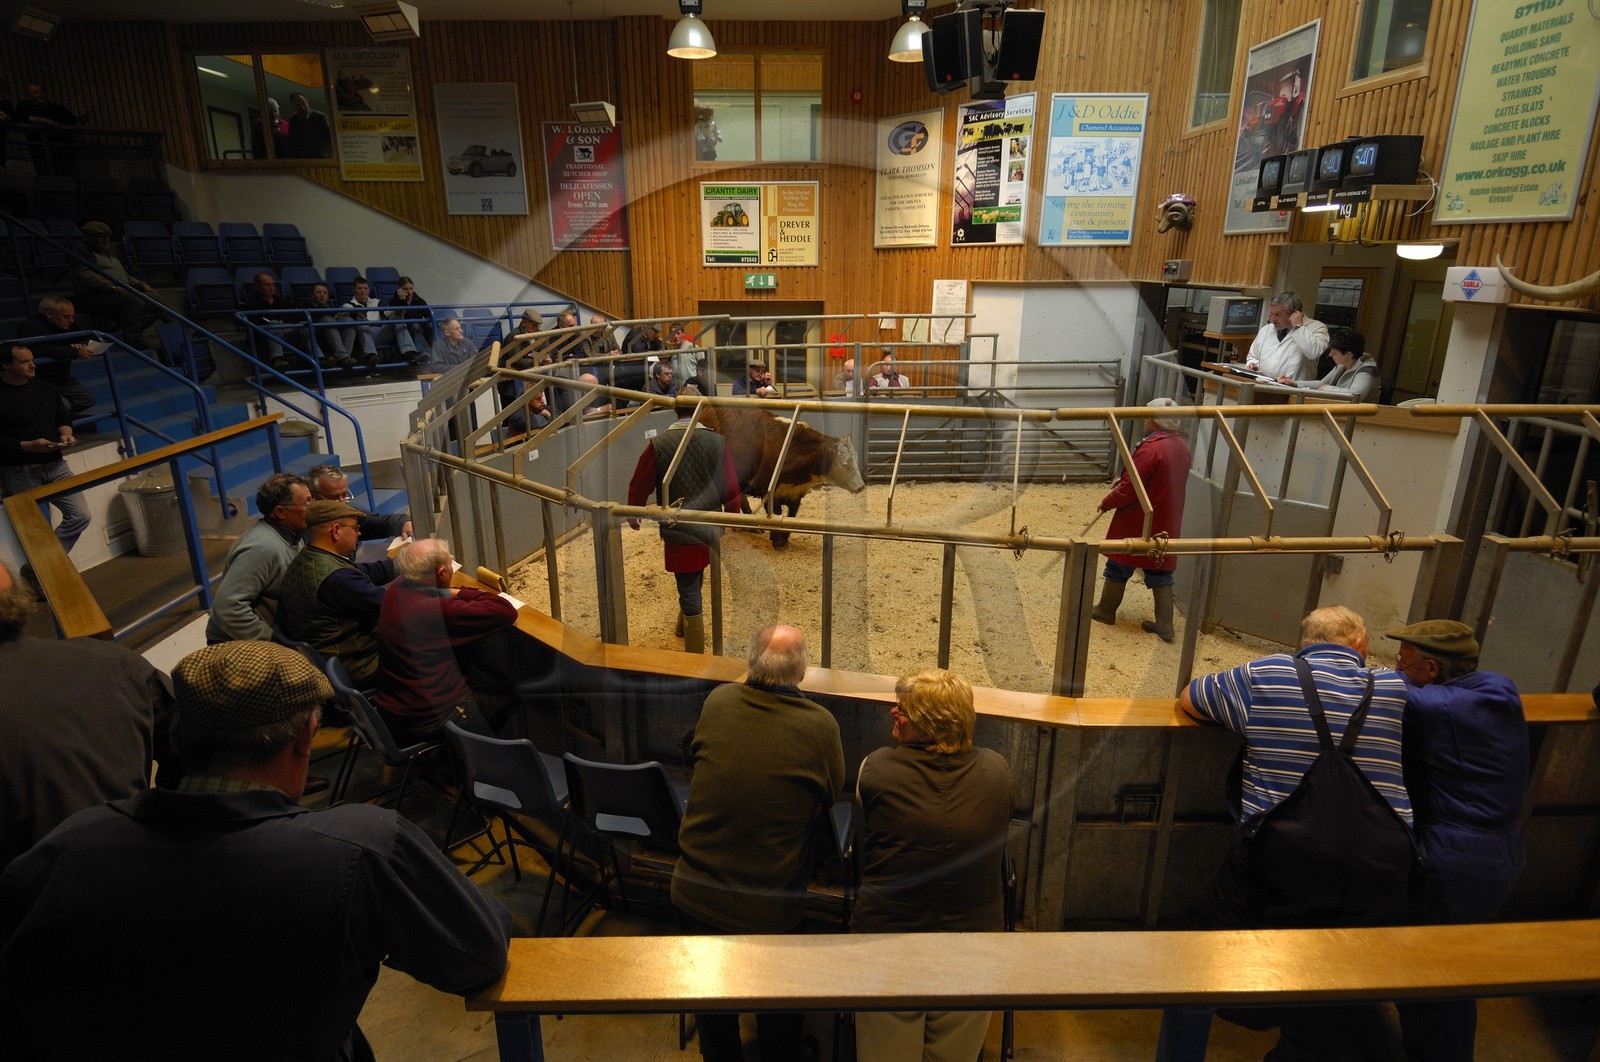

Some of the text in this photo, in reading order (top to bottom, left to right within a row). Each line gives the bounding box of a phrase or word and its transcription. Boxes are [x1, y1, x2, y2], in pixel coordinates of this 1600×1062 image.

[1500, 12, 1574, 42] QUARRY MATERIALS
[1504, 32, 1562, 56] BUILDING SAND
[1491, 46, 1570, 75] READYMIX CONCRETE
[1496, 66, 1557, 88] WATER TROUGHS
[1502, 84, 1543, 102] STRAINERS
[980, 112, 1004, 121] Advisory
[1006, 108, 1032, 116] Services
[1068, 105, 1080, 118] &
[1082, 104, 1096, 119] D
[1098, 104, 1140, 120] Oddie
[1494, 100, 1544, 118] CATTLE SLATS
[341, 120, 376, 130] William
[551, 126, 614, 134] W. LOBBAN
[1483, 114, 1551, 135] CONCRETE BLOCKS
[566, 136, 600, 144] & SON
[1470, 129, 1562, 152] HAULAGE AND PLANT HIRE
[1492, 150, 1527, 164] SKIP HIRE
[880, 163, 936, 176] CLARK THOMSON
[1456, 159, 1567, 182] www.orkagg.co.uk
[572, 192, 601, 200] OPEN
[1491, 185, 1519, 195] Industrial
[1520, 184, 1539, 193] Estate
[1050, 200, 1128, 210] Serving the farming
[1488, 194, 1514, 203] Kirkwall
[1071, 210, 1114, 218] community
[780, 220, 810, 228] DREVER
[1070, 218, 1086, 227] past
[1098, 218, 1127, 228] present
